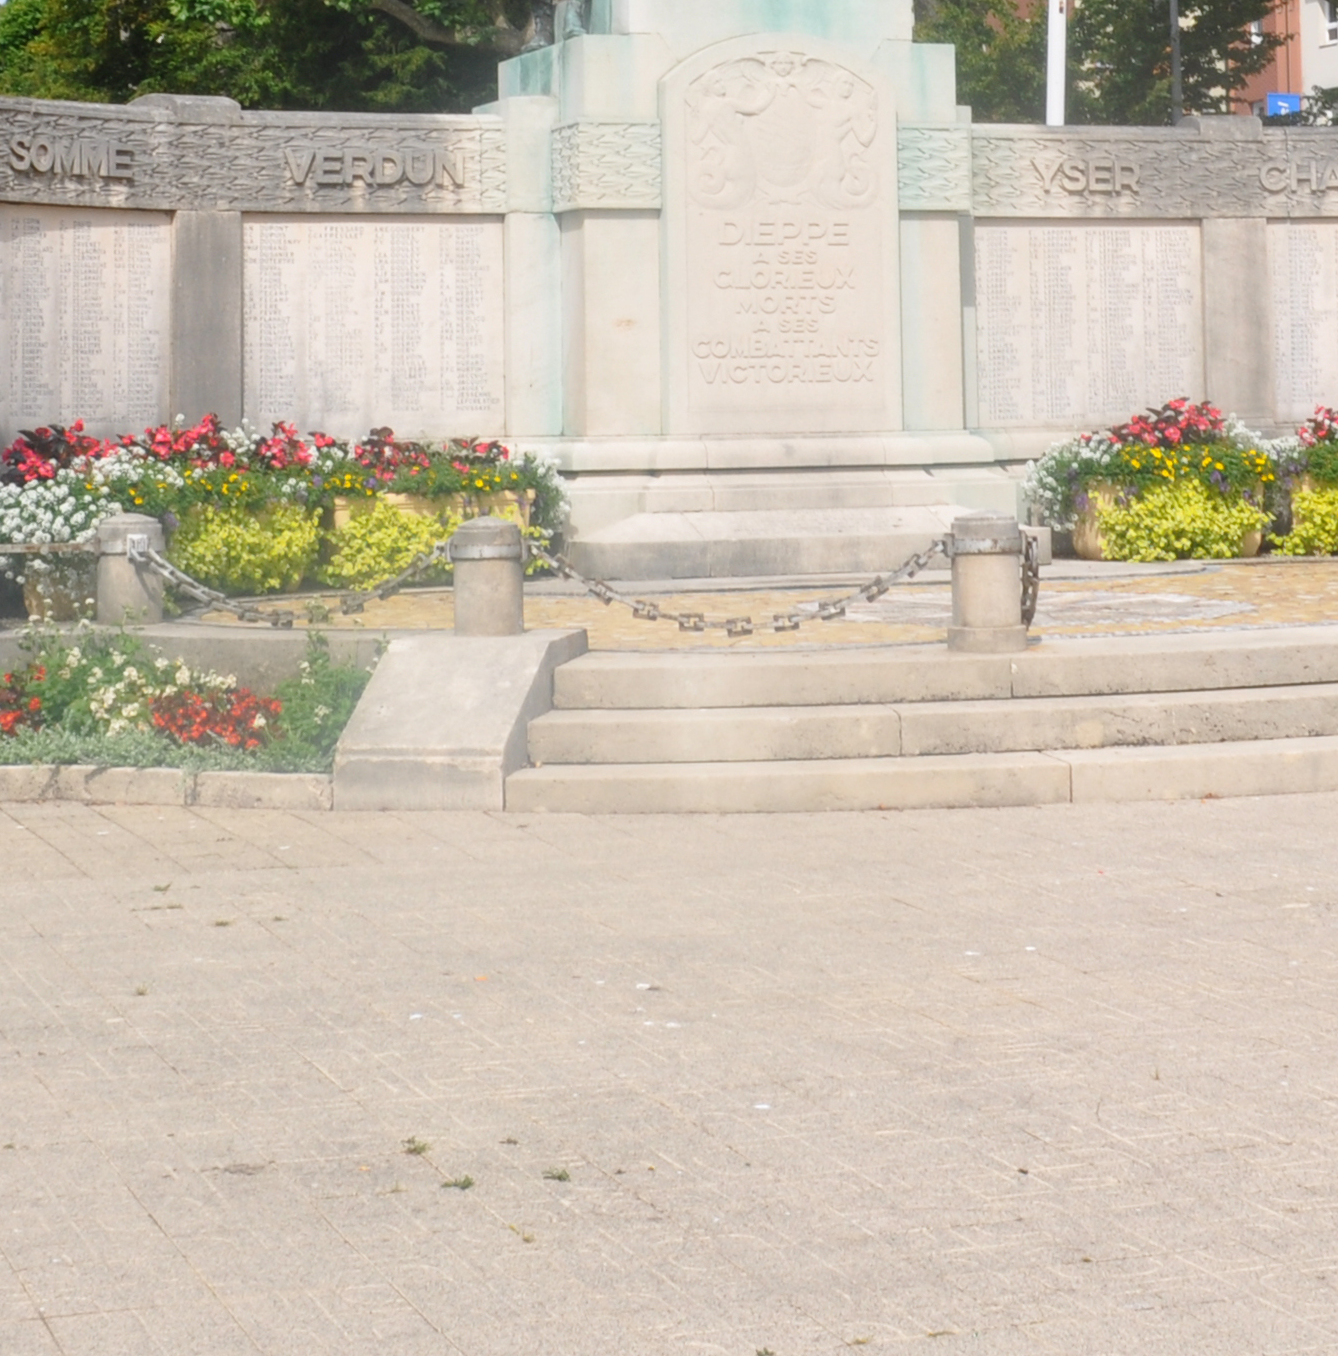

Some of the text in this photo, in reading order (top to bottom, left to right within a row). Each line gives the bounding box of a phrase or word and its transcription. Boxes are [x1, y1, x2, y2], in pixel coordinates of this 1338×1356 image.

[9, 138, 135, 179] SOMME
[284, 148, 467, 186] VERDUN
[1031, 157, 1142, 194] YSER
[718, 221, 850, 247] DIEPPE
[752, 250, 818, 265] A SES
[713, 268, 855, 290] GLORIEUX
[735, 295, 837, 314] MORTS
[752, 319, 819, 334] A SES
[691, 338, 880, 359] COMBATTANTS
[699, 361, 874, 384] VICTORIEUX
